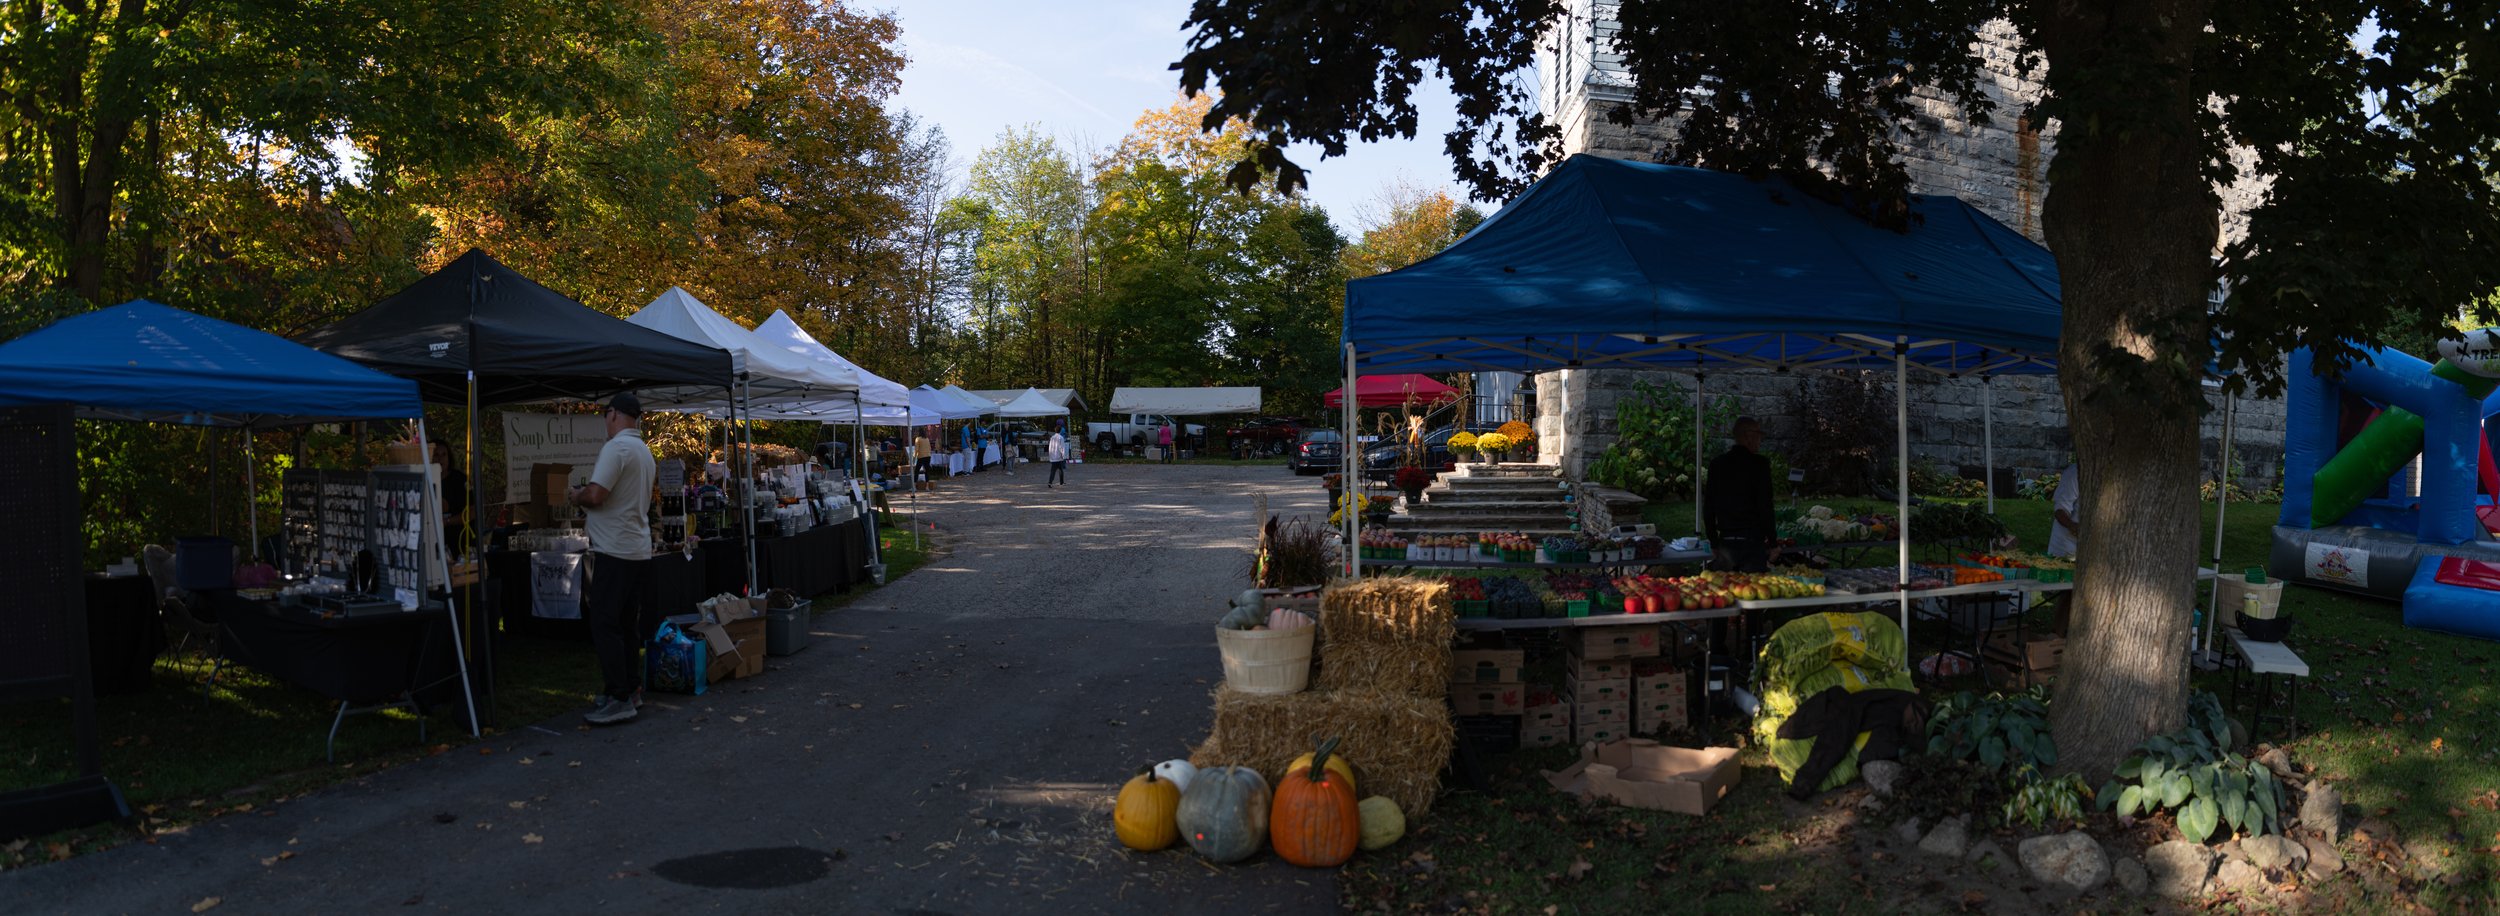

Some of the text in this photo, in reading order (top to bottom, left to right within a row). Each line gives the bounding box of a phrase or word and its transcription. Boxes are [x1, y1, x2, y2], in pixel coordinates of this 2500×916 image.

[2456, 342, 2500, 362] XTRE
[510, 417, 574, 449] Soup Girl
